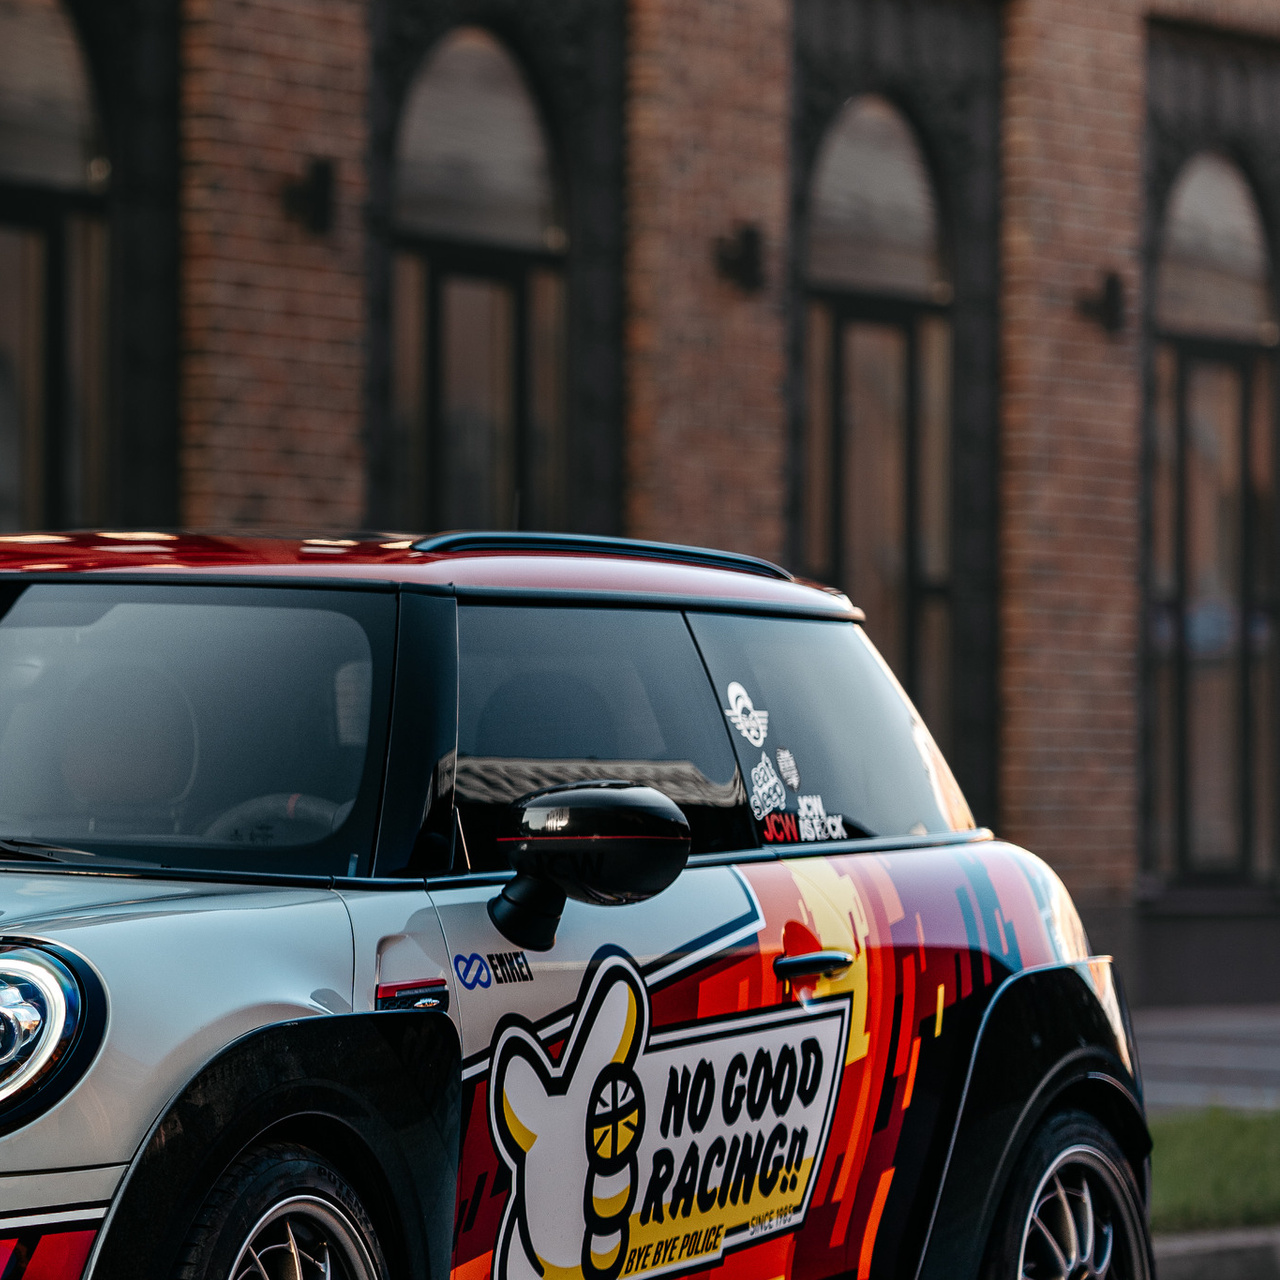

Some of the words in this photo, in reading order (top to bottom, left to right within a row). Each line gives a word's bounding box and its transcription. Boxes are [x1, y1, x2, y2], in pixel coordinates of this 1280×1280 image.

[751, 754, 776, 789] eat
[750, 782, 785, 820] sleep
[797, 794, 826, 820] JCW
[764, 813, 798, 842] JCW
[486, 951, 534, 984] ENKEI
[660, 1058, 716, 1140] NO
[722, 1036, 824, 1127] GOOD
[639, 1122, 809, 1227] RACING!!
[624, 1243, 651, 1275] BYE
[651, 1234, 680, 1267] BYE
[678, 1224, 725, 1261] POLICE
